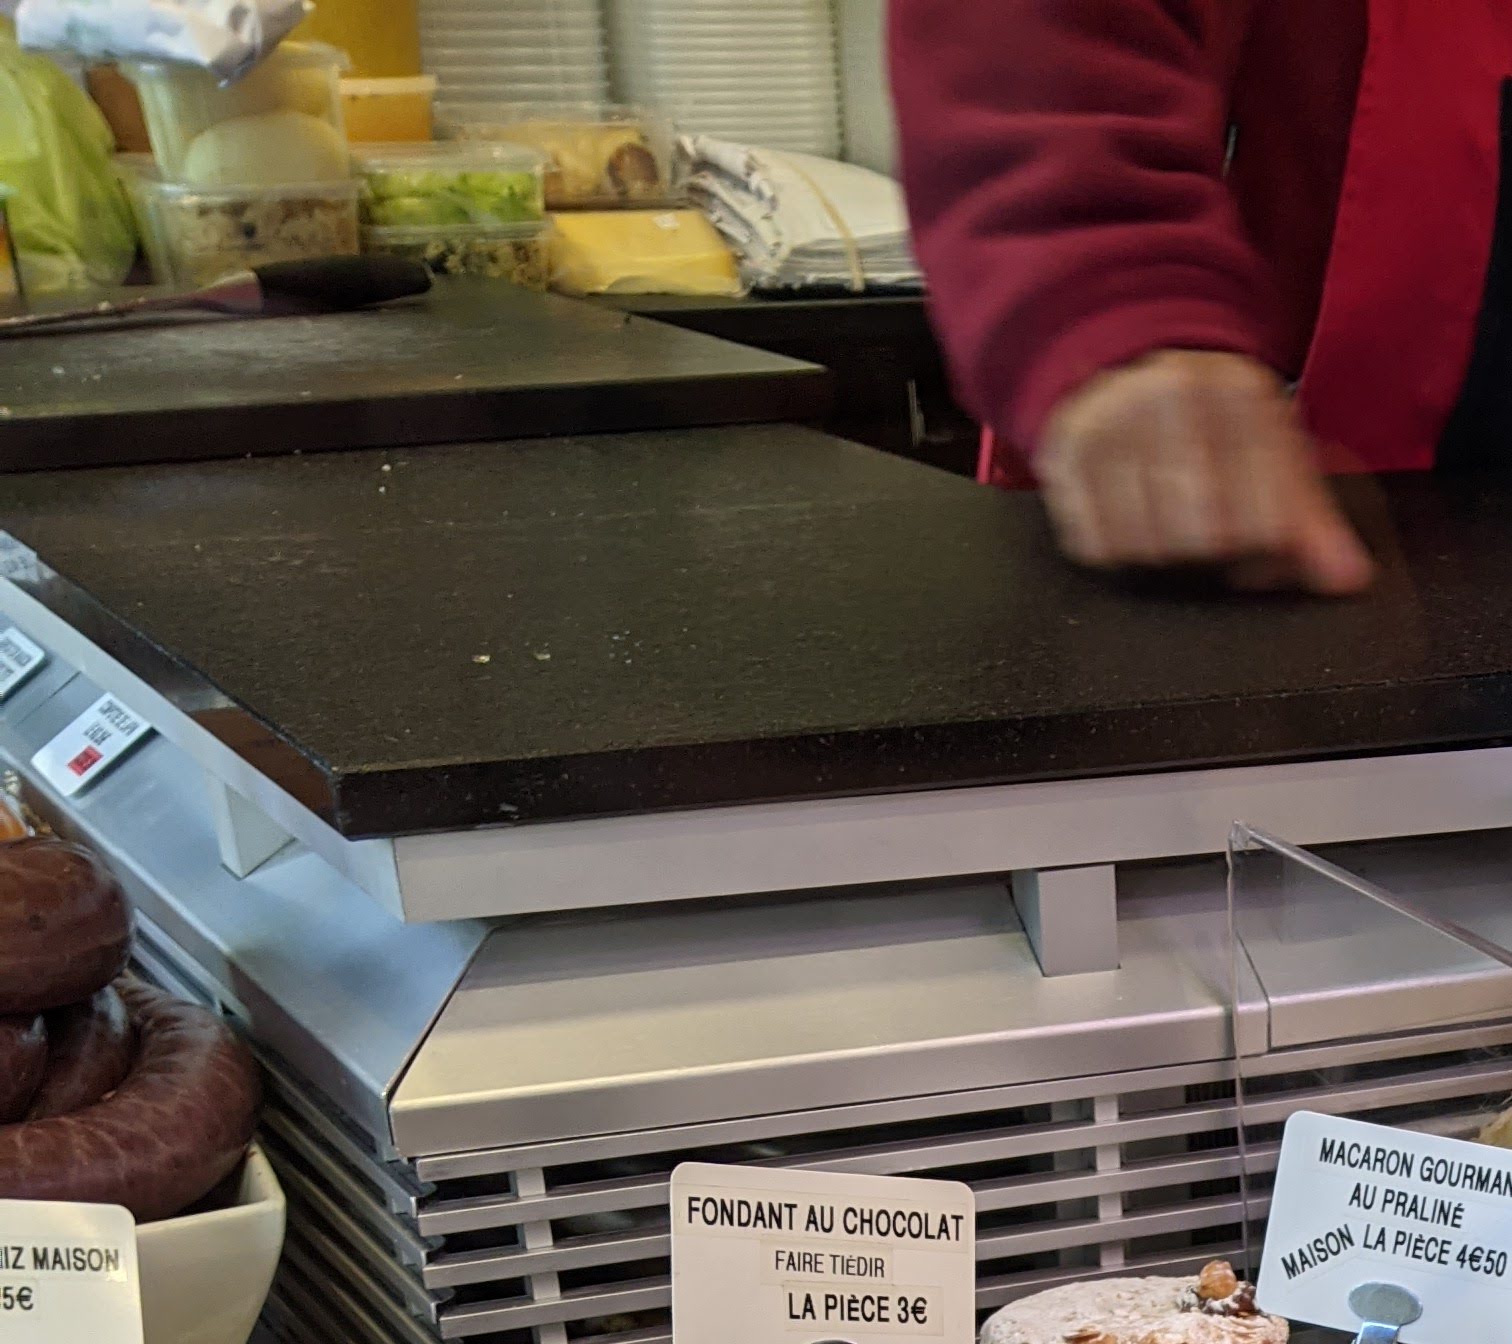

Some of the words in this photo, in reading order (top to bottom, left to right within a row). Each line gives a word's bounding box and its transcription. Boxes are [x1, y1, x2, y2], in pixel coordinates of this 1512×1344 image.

[1318, 1137, 1414, 1178] MACARON
[688, 1196, 797, 1230] FONDANT
[805, 1205, 834, 1233] AU
[843, 1207, 964, 1241] CHOCOLAT
[1348, 1182, 1377, 1210] AU
[1381, 1189, 1466, 1229] PRALINÉ
[0, 1246, 25, 1270] IZ
[33, 1247, 120, 1272] MAISON
[775, 1250, 825, 1274] FAIRE
[1281, 1223, 1355, 1280] MAISON
[1363, 1224, 1387, 1252] LA
[1392, 1230, 1452, 1266] PIÈCE
[1455, 1244, 1508, 1278] 4€50
[0, 1286, 33, 1311] 5€
[788, 1292, 816, 1321] LA
[825, 1294, 890, 1323] PIÈCE
[897, 1296, 928, 1324] 3€
